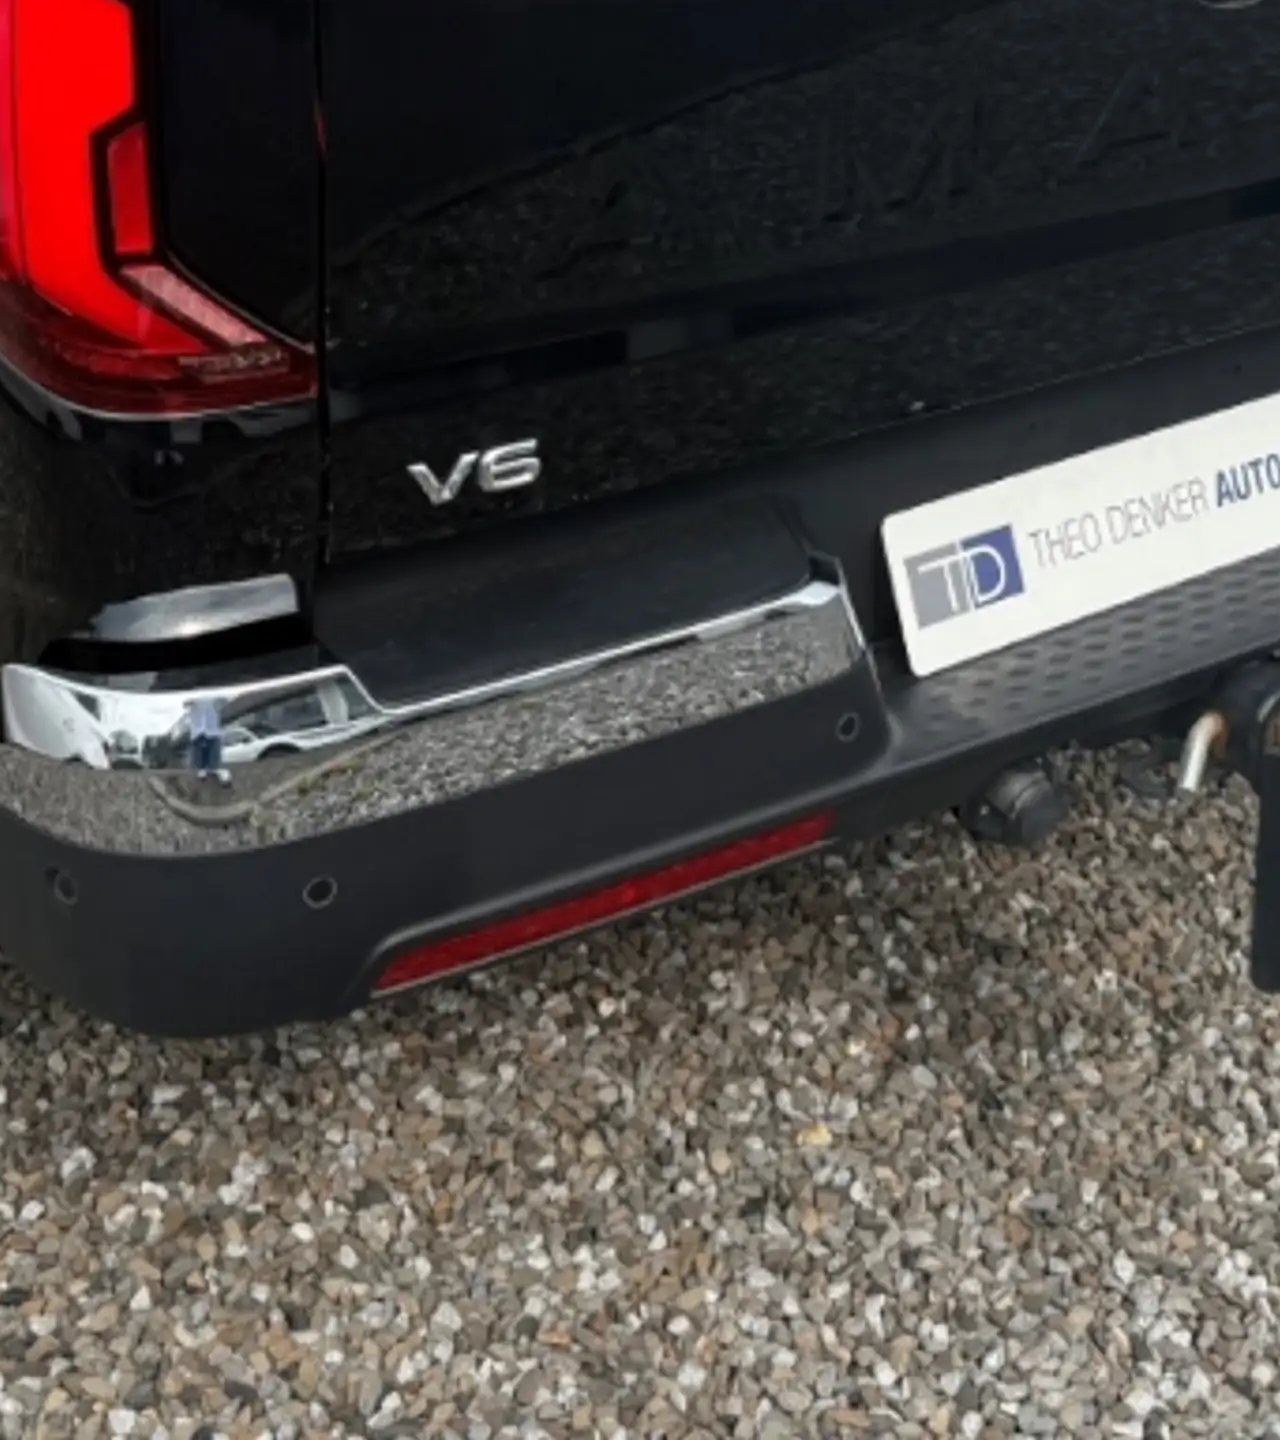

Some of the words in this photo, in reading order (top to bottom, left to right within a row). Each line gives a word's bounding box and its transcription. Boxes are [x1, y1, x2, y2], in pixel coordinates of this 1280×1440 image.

[406, 438, 541, 506] V6
[1028, 514, 1102, 570] THEO
[1104, 478, 1210, 545] DENKER
